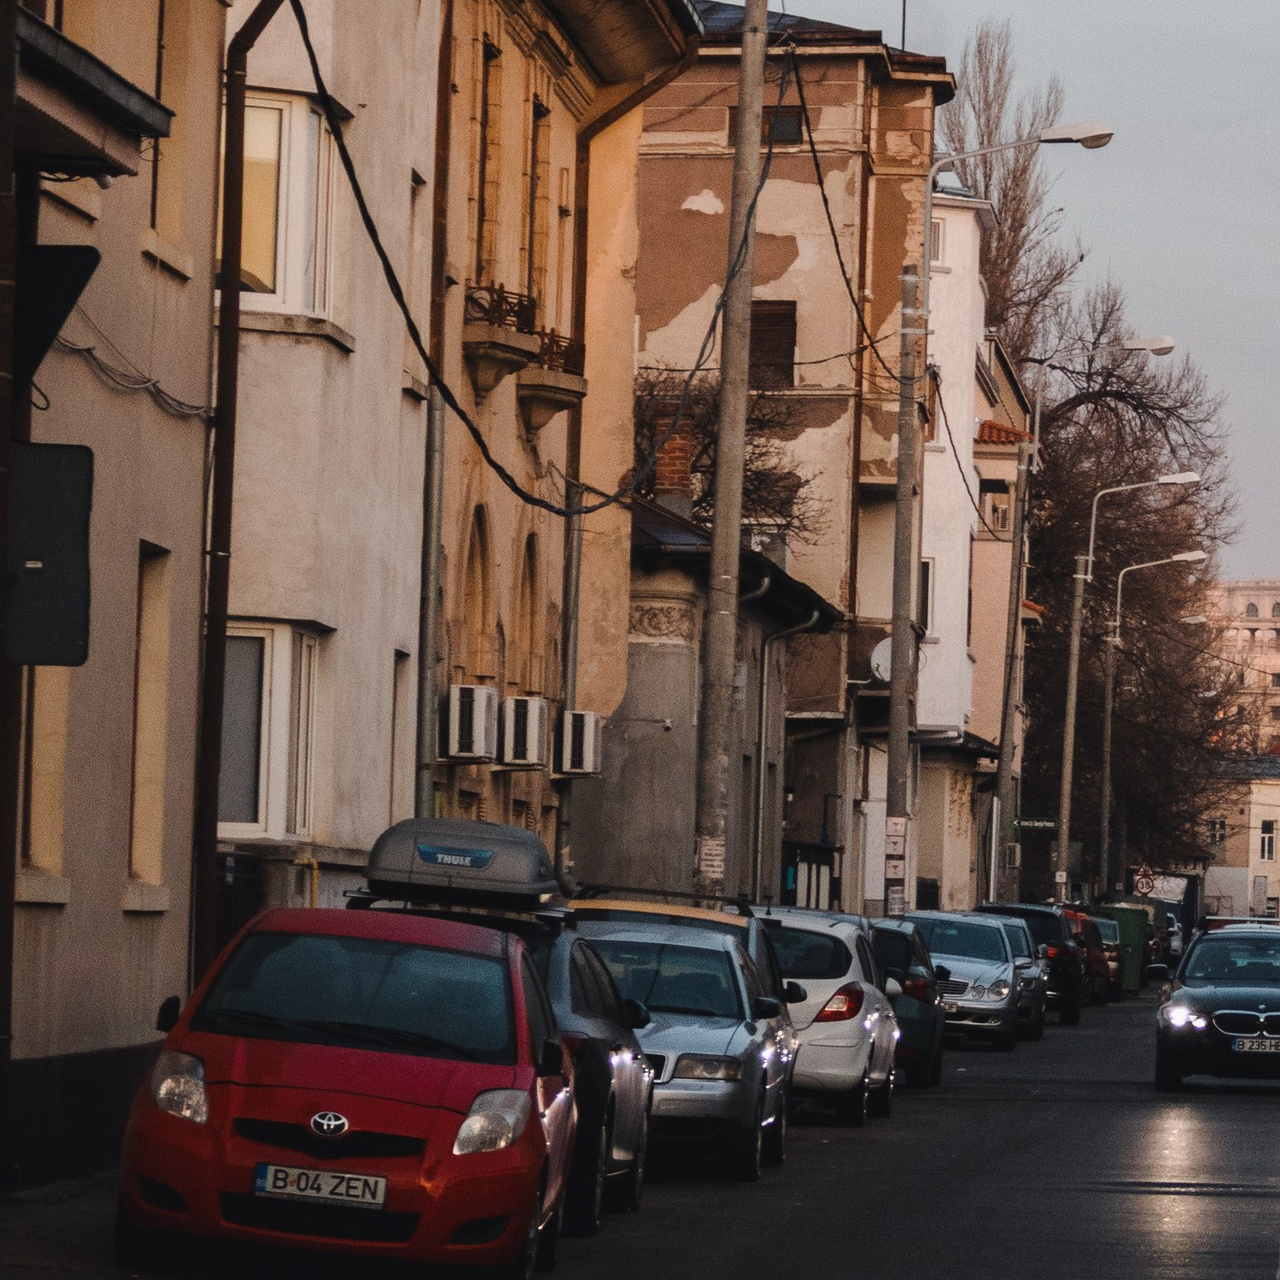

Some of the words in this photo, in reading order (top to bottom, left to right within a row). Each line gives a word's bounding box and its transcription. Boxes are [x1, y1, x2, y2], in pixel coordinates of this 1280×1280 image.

[436, 853, 472, 868] THULE
[1237, 1040, 1245, 1050] B
[1248, 1040, 1267, 1051] 235
[272, 1168, 289, 1190] B
[296, 1171, 322, 1194] 04
[329, 1174, 379, 1200] ZEN
